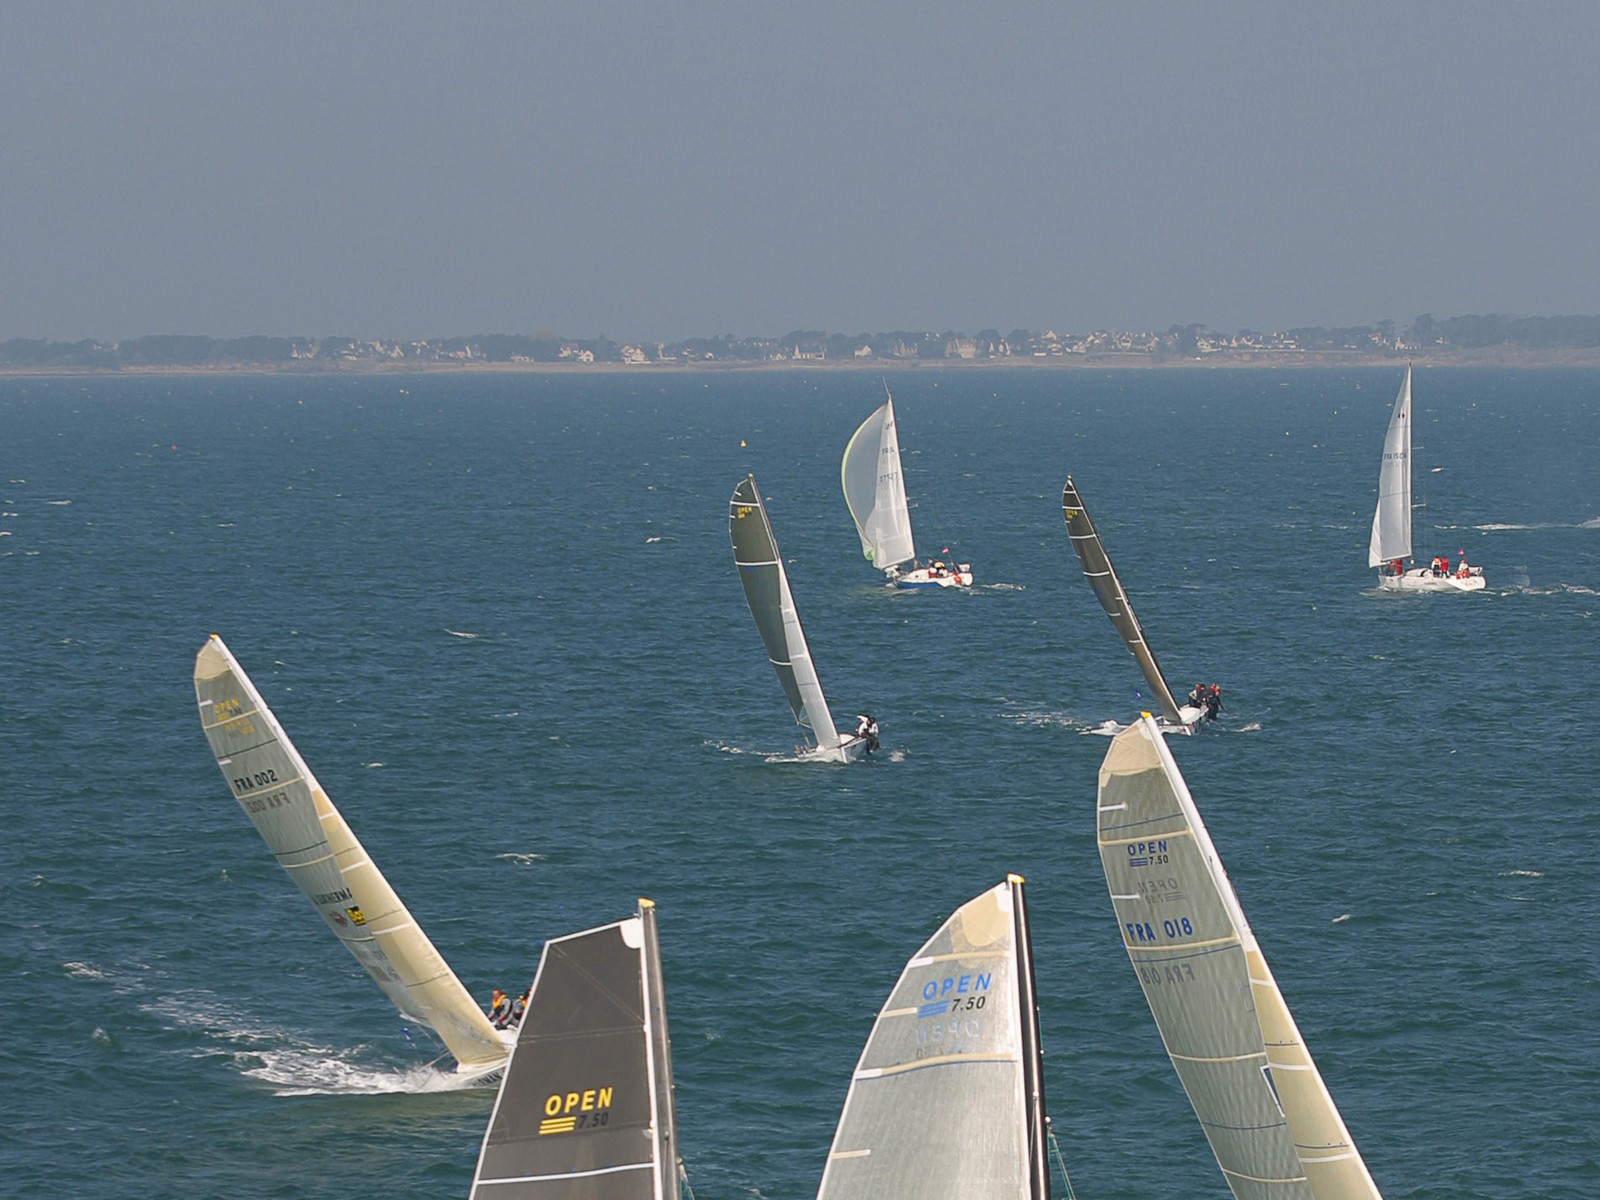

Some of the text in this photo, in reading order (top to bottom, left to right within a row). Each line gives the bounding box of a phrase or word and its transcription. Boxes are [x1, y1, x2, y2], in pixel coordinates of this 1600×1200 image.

[214, 697, 239, 714] OPEN
[234, 769, 278, 792] FRA 002
[1127, 840, 1168, 856] OPEN
[1149, 855, 1169, 866] 7.50
[1126, 917, 1193, 942] FRA 018
[923, 972, 992, 1000] OPEN
[951, 996, 986, 1012] 7.50
[545, 1087, 613, 1115] OPEN
[578, 1112, 609, 1129] 7.50
